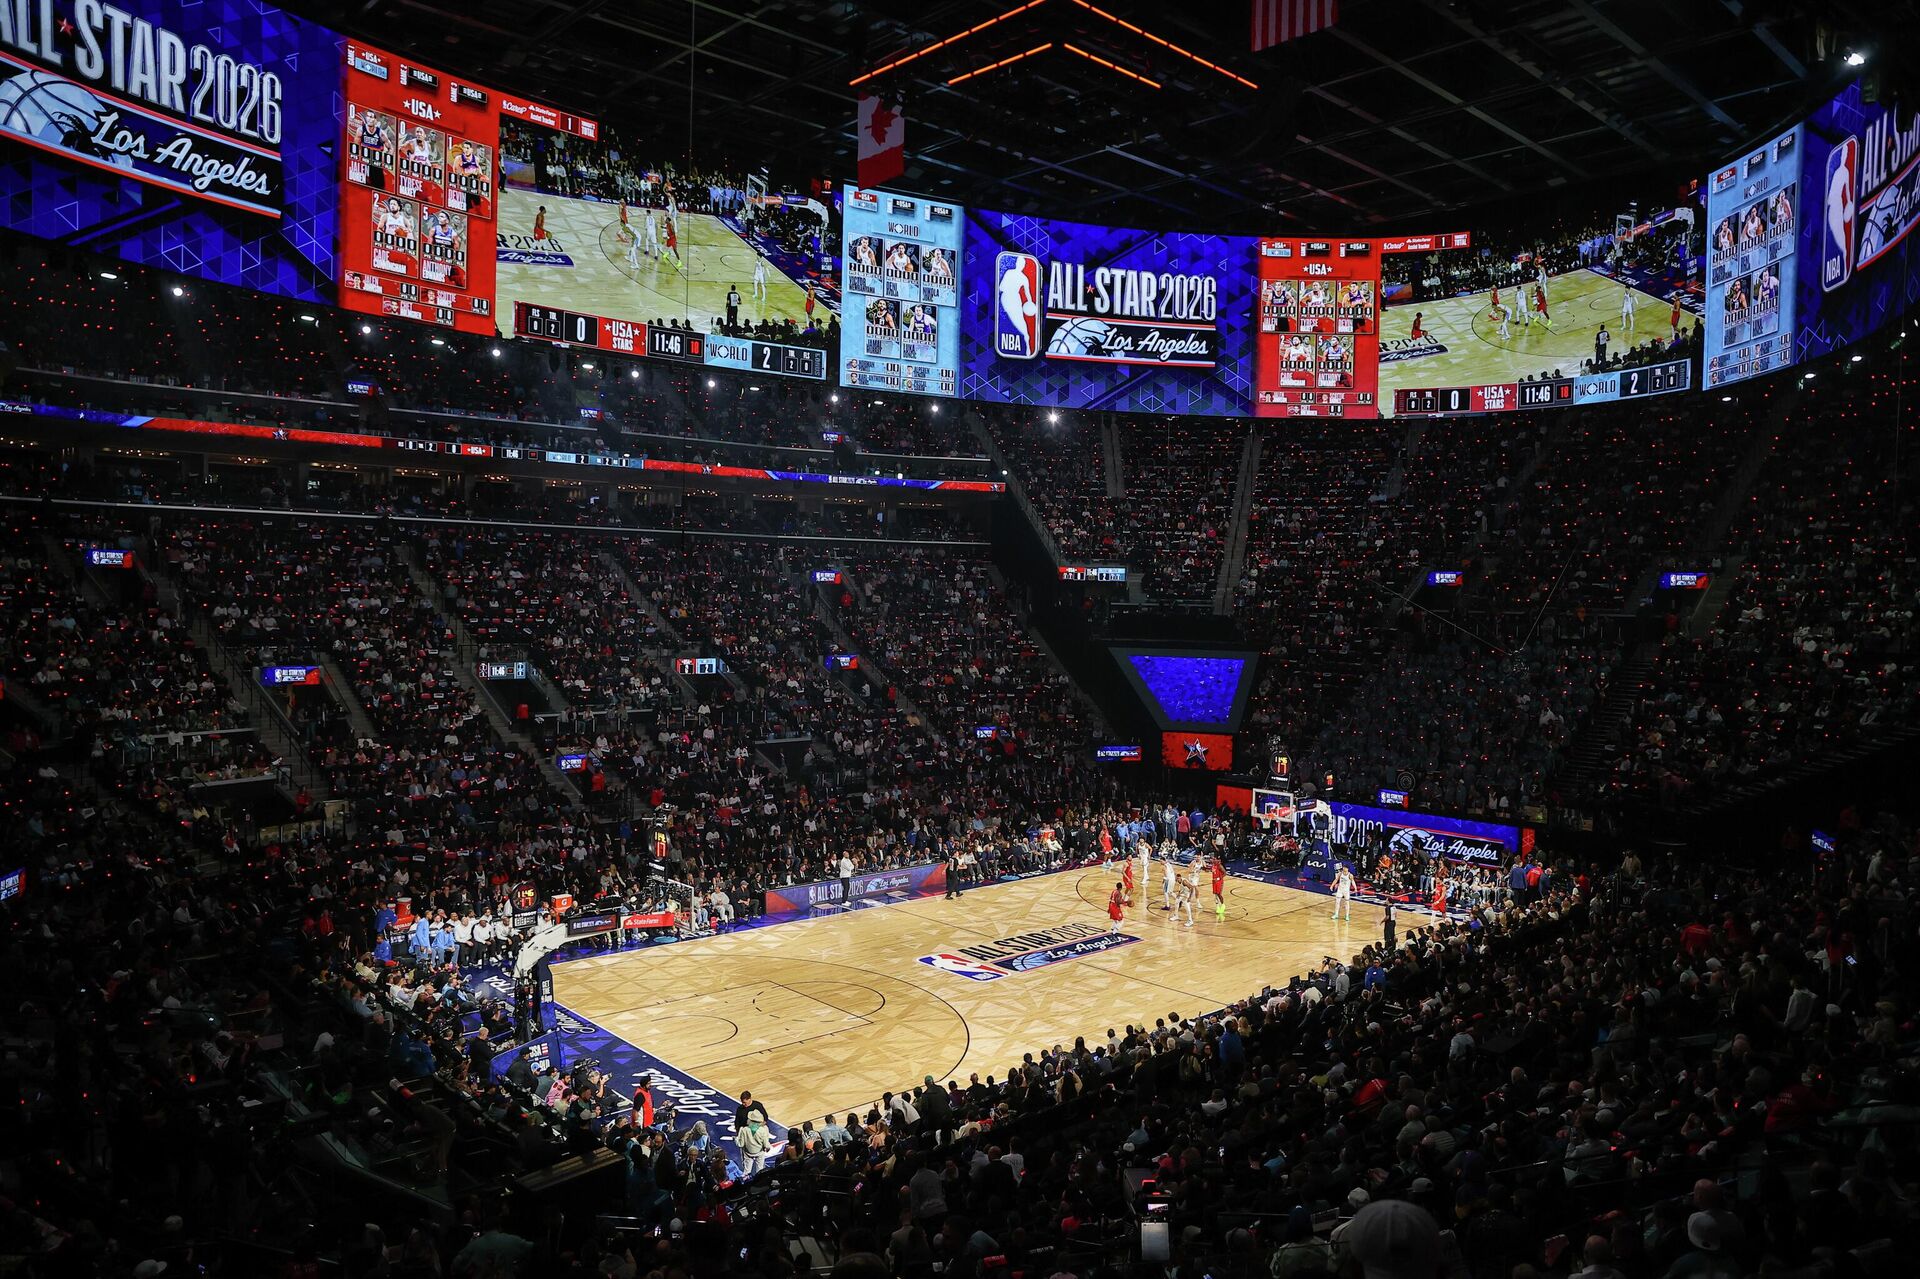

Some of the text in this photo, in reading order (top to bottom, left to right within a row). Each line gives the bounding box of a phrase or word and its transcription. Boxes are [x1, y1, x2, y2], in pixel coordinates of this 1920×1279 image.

[365, 51, 378, 63] USA
[74, 0, 187, 115] STAR
[190, 44, 282, 144] 2026
[417, 70, 430, 82] USA
[466, 88, 478, 98] USA
[411, 98, 434, 120] USA
[400, 122, 406, 135] 0
[568, 117, 572, 130] 1
[91, 111, 272, 196] Los Angeles
[1860, 111, 1888, 198] ALL
[374, 193, 380, 208] 2
[423, 206, 428, 220] 5
[888, 222, 919, 237] WORLD
[1442, 236, 1445, 246] 1
[1310, 264, 1327, 275] USA
[1826, 255, 1841, 283] NBA
[1050, 260, 1216, 322] ALL STAR 2026
[550, 324, 555, 334] 2
[576, 317, 586, 342] 0
[612, 320, 634, 339] USA
[612, 336, 634, 351] STARS
[655, 332, 681, 354] 11:46
[1001, 333, 1022, 352] NBA
[1102, 327, 1209, 362] Los Angeles
[710, 343, 748, 362] WORLD
[762, 346, 770, 369] 2
[790, 360, 794, 370] 2
[1580, 380, 1616, 396] WORLD
[1630, 373, 1638, 394] 2
[1656, 380, 1660, 388] 2
[1450, 390, 1459, 410] 0
[1484, 386, 1504, 400] USA
[1525, 386, 1550, 404] 11:46
[1426, 400, 1430, 408] 2
[1484, 399, 1504, 410] STARS
[429, 442, 433, 452] 2
[470, 446, 482, 455] USA
[580, 455, 584, 464] 2
[1424, 836, 1498, 862] Los Angeles
[818, 880, 864, 902] ALL STA 2026
[958, 922, 1107, 962] ALL STAR 2026
[1047, 936, 1130, 961] Los Angeles
